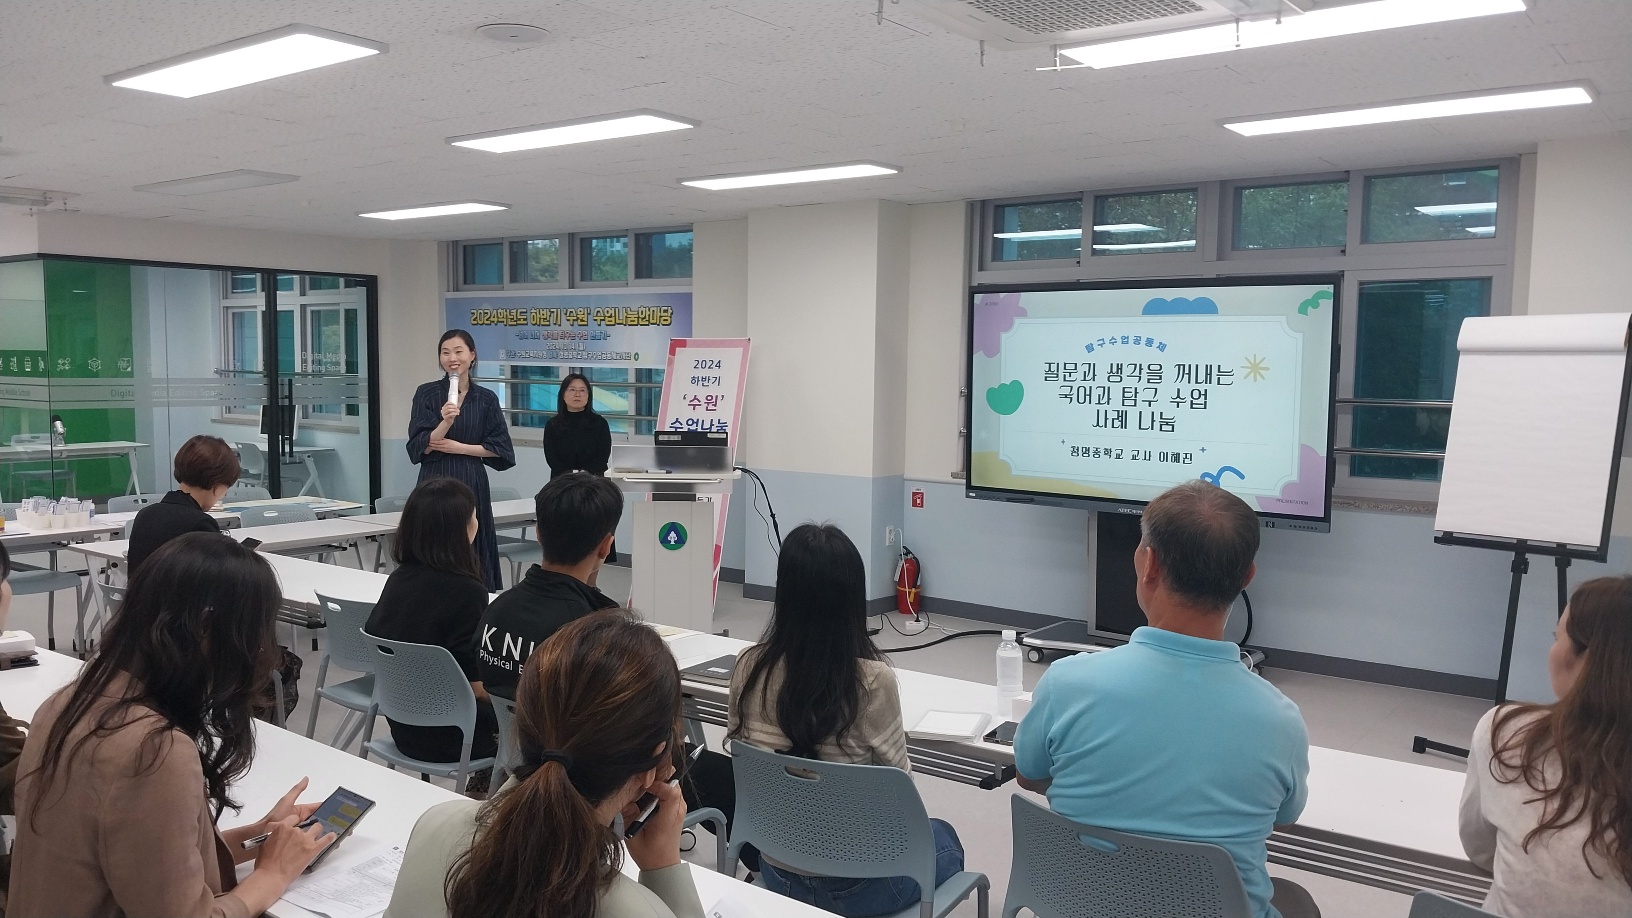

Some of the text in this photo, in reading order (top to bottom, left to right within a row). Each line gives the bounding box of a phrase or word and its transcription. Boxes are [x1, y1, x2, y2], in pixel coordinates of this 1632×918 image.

[471, 305, 673, 327] 2024학년도 하반기 '수원' 수업나눔한마당
[1084, 335, 1167, 353] 탐구수업공동체
[693, 360, 721, 369] 2024
[1044, 362, 1235, 386] 질문과 생각을 꺼내는
[690, 376, 721, 387] 하반기
[1058, 385, 1208, 409] 국어과 탐구 수업
[1092, 409, 1176, 432] 사례 나눔
[1130, 449, 1152, 462] 교사
[1158, 451, 1193, 465] 이혜진
[479, 649, 512, 671] Physical
